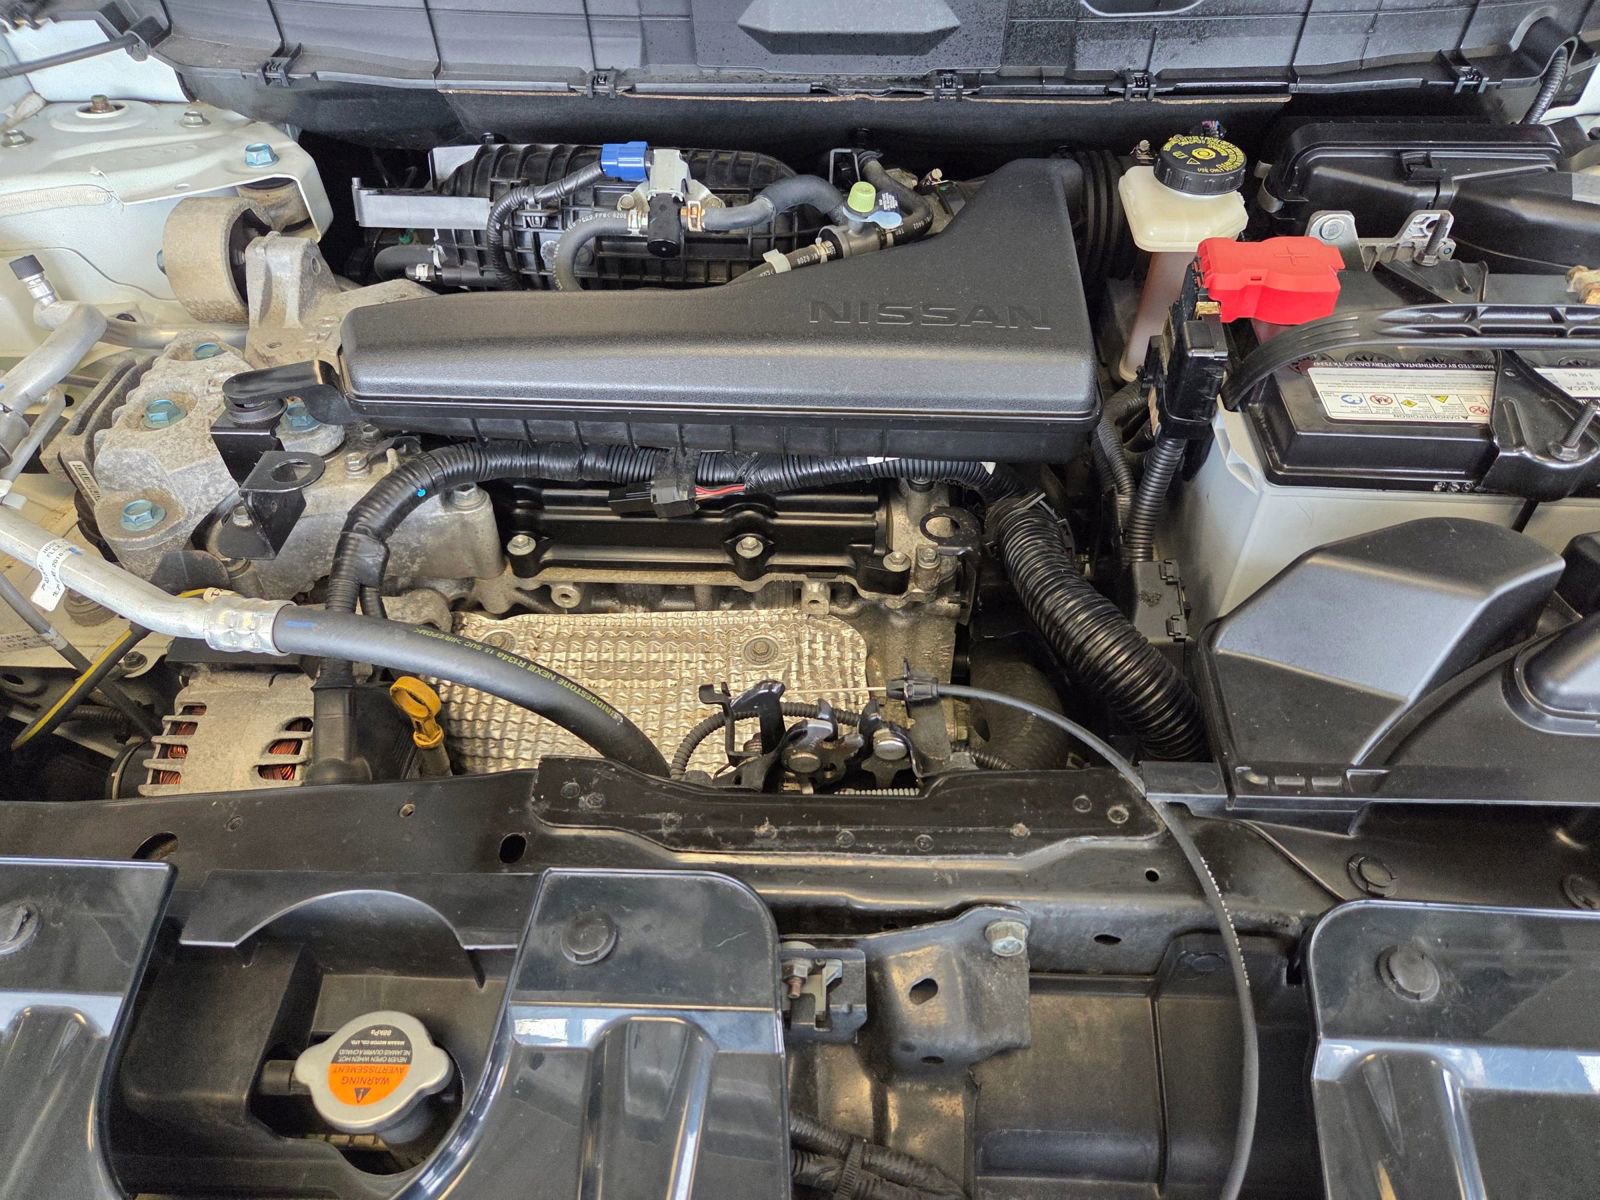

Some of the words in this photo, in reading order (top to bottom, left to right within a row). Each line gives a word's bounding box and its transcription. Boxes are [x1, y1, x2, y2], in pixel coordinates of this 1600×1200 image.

[809, 300, 1051, 330] NISSAN
[332, 1065, 404, 1073] AVERTISSEMENT
[341, 1076, 389, 1085] WARNING
